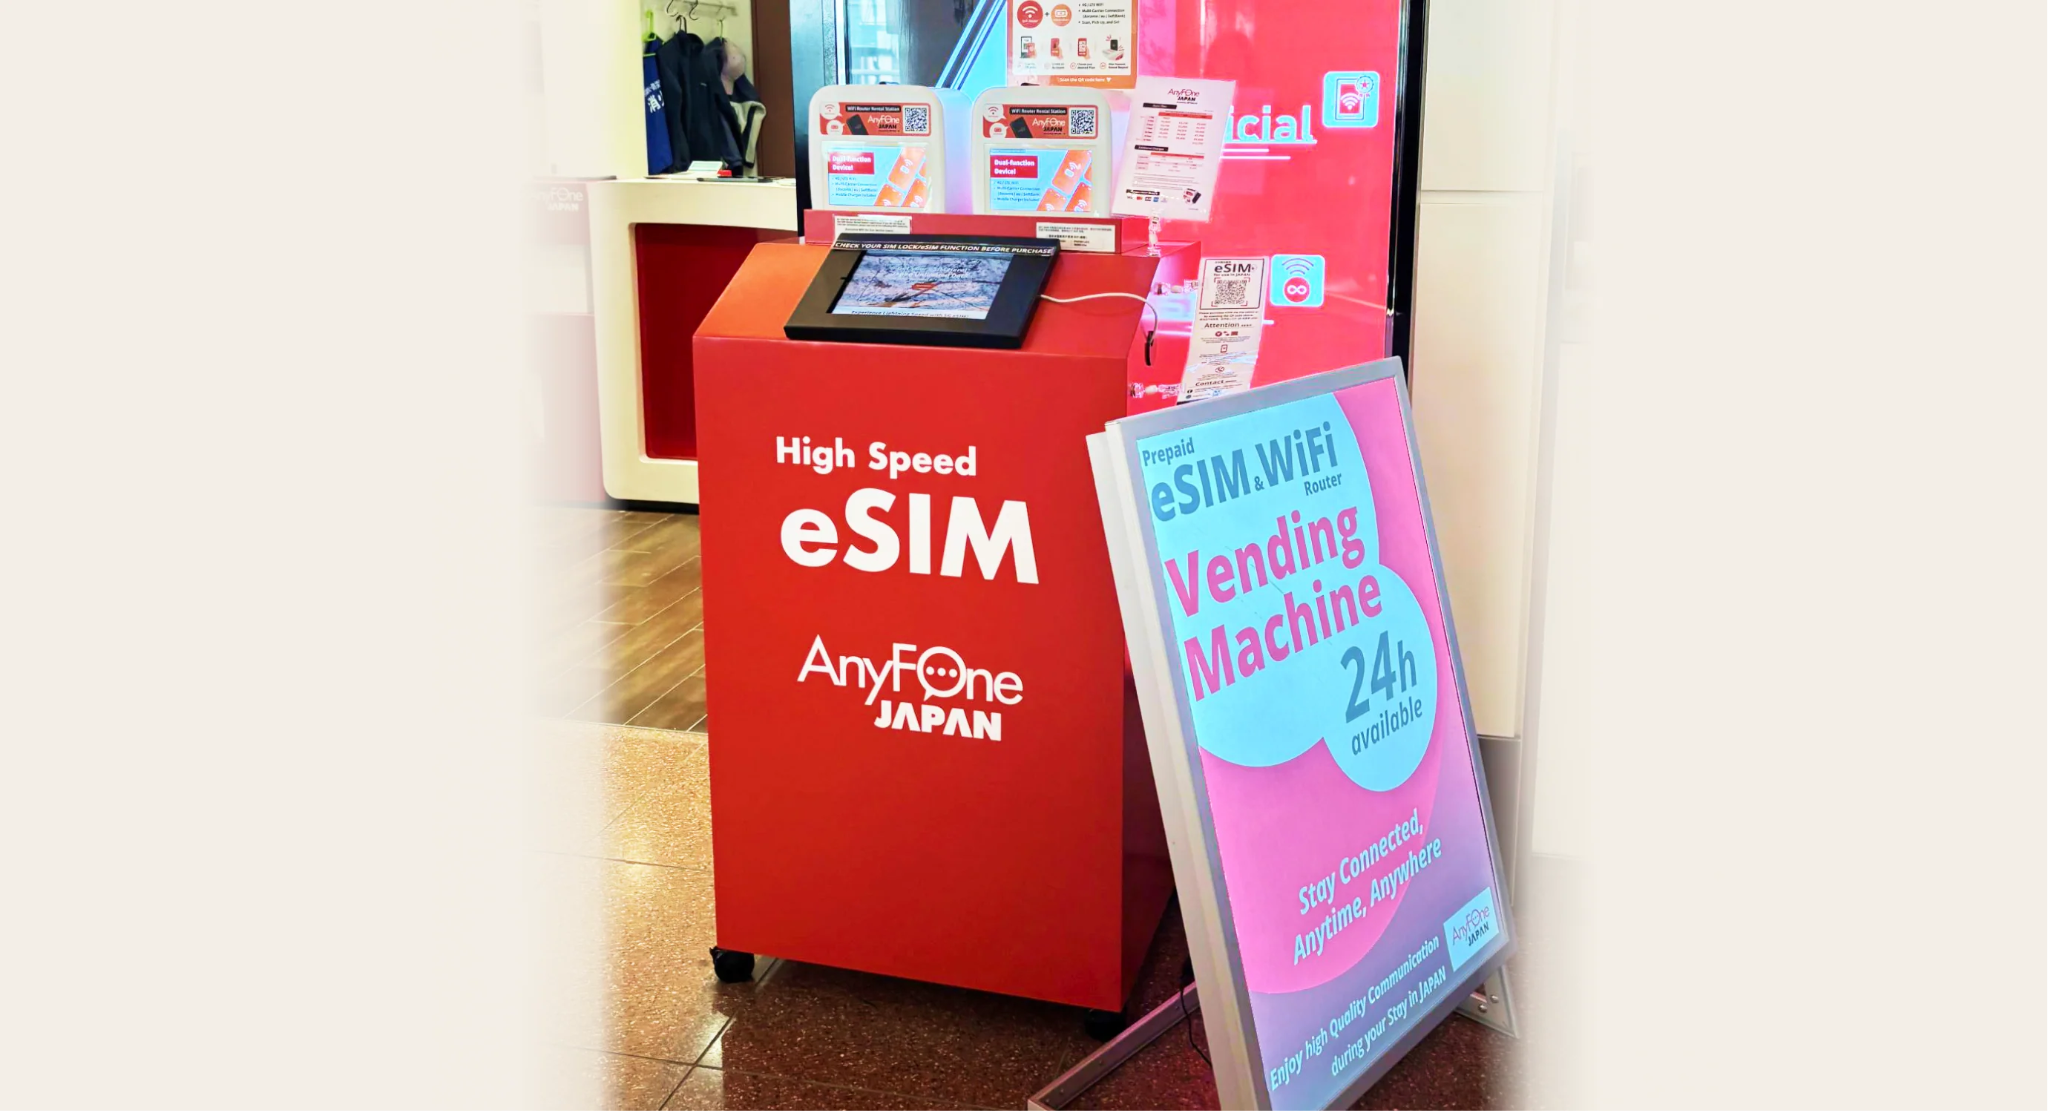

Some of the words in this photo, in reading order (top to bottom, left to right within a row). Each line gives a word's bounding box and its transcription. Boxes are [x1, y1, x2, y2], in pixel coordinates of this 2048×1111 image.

[1168, 89, 1200, 97] AnyFOne
[1214, 264, 1251, 273] eSIM
[776, 436, 855, 475] High
[868, 441, 977, 480] Speed
[1142, 436, 1195, 467] Prepaid
[1151, 448, 1251, 522] eSIM
[1254, 420, 1338, 491] WiFi
[1254, 475, 1265, 491] &
[1304, 471, 1343, 496] Router
[780, 487, 1039, 585] eSIM
[1164, 505, 1366, 618] Vending
[797, 633, 1024, 706] AnyFOne
[1183, 574, 1383, 702] Machine
[1340, 630, 1418, 724] 24h
[873, 699, 1002, 742] JAPAN
[1351, 697, 1423, 756] available
[1299, 871, 1336, 916] Stay
[1338, 807, 1424, 884] Connected,
[1293, 896, 1368, 966] Anytime,
[1369, 837, 1442, 909] Anywhere
[1451, 904, 1491, 946] AnyFOne
[1467, 922, 1490, 947] JAPAN
[1269, 1049, 1304, 1091] Enjoy
[1305, 1028, 1328, 1061] high
[1329, 998, 1367, 1038] Quality
[1367, 935, 1440, 1005] Communication
[1330, 1037, 1365, 1076] during
[1365, 1017, 1386, 1050] your
[1387, 999, 1408, 1026] Stay
[1409, 991, 1419, 1006] in
[1419, 965, 1447, 1002] JAPAN
